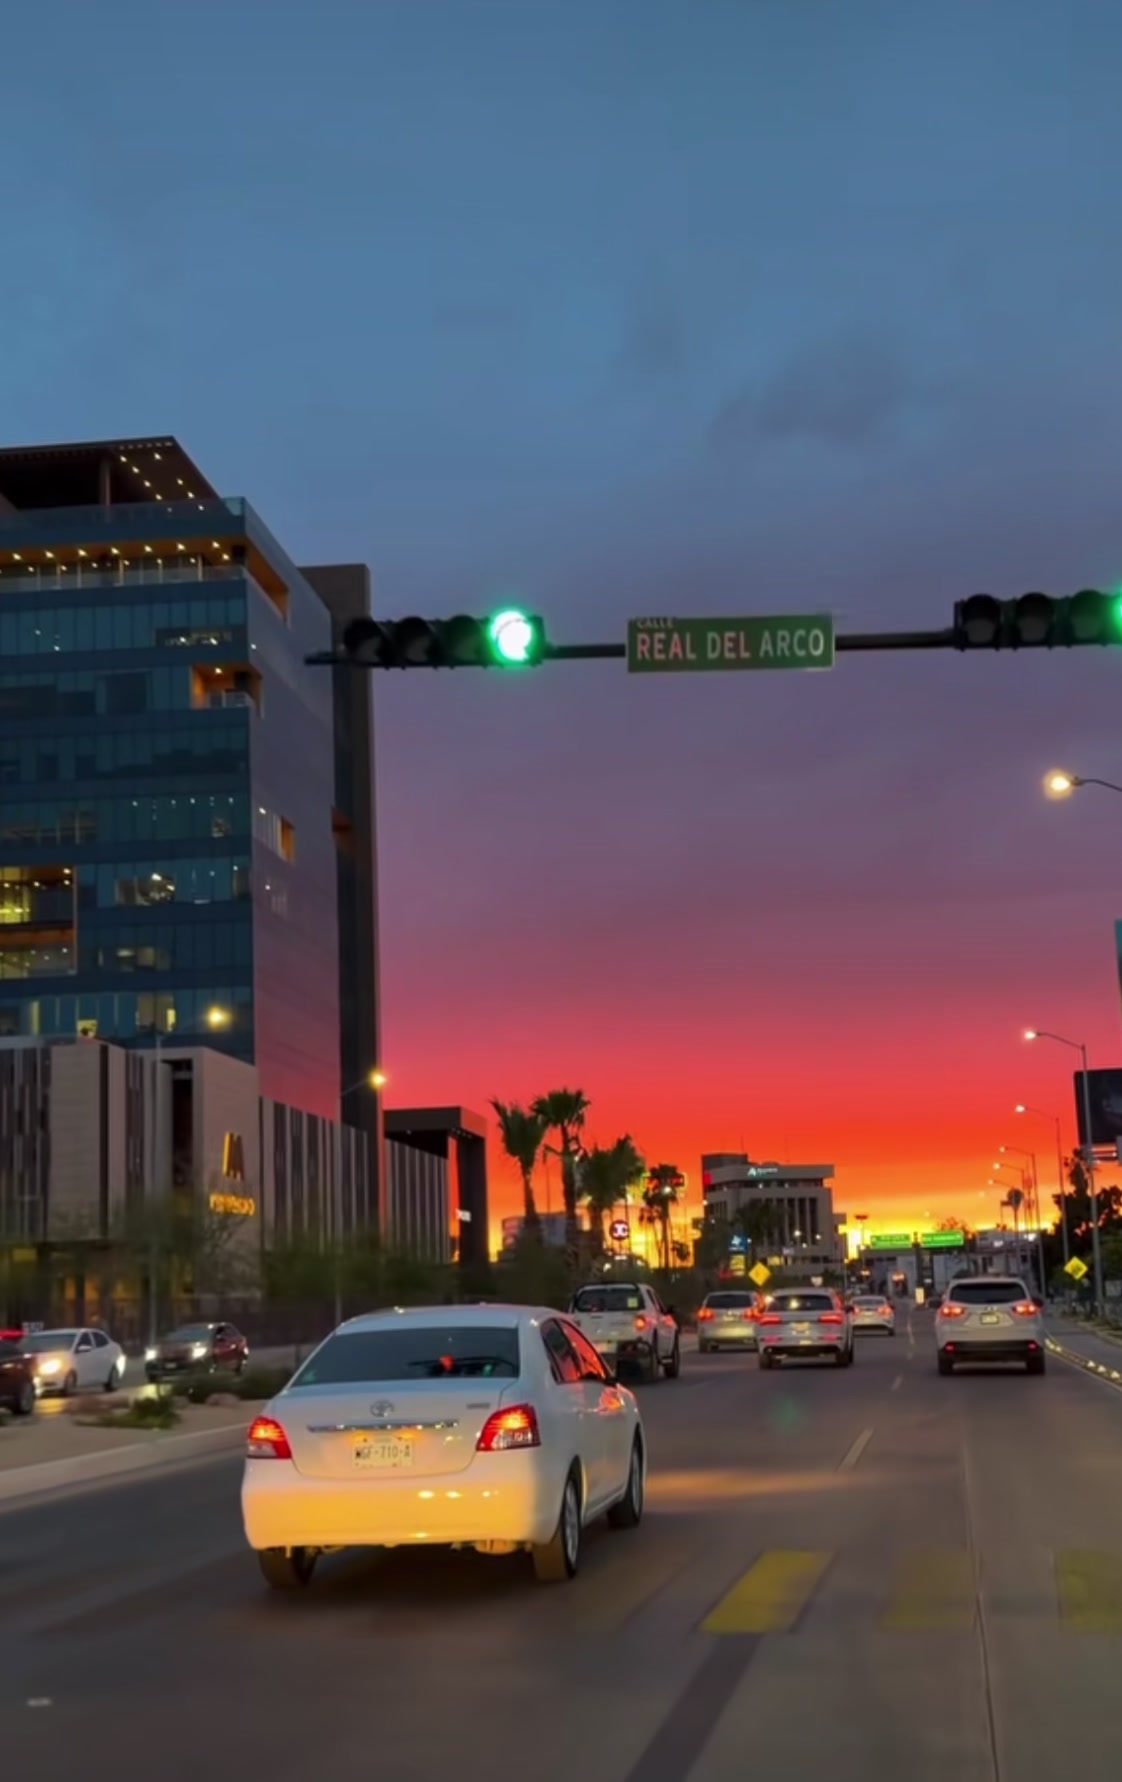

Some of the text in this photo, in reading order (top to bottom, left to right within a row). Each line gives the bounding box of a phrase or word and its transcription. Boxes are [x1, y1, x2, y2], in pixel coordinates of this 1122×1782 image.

[637, 629, 825, 660] REAL DEL ARCO
